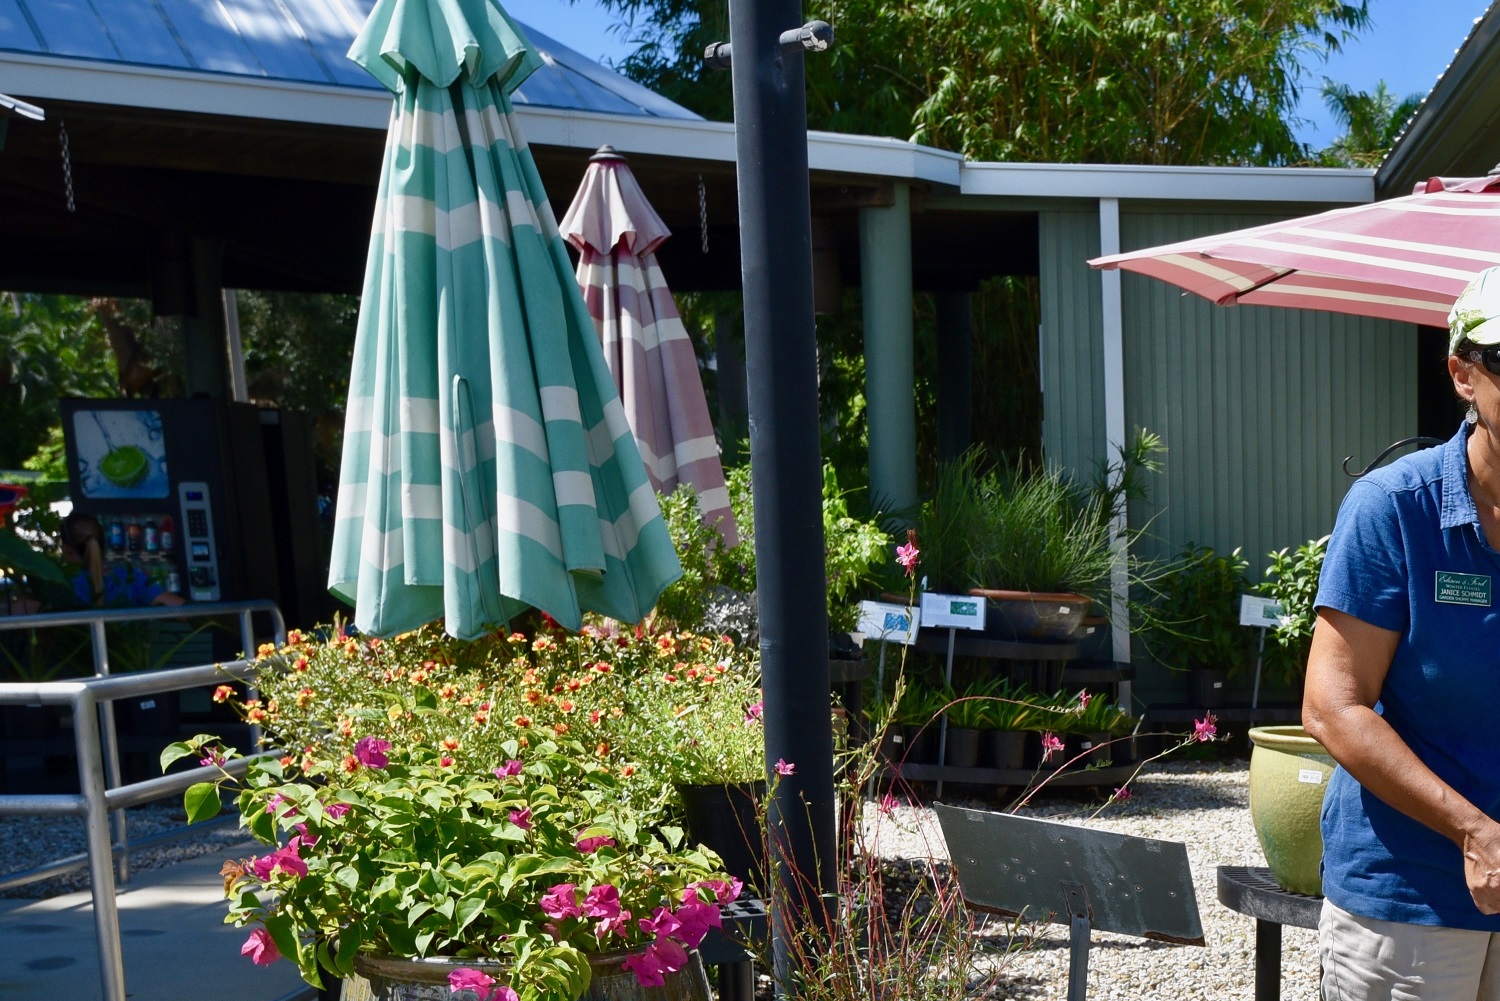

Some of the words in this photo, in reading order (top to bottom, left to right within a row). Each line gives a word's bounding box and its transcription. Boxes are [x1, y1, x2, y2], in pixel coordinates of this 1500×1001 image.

[1470, 576, 1488, 587] Ford
[1440, 588, 1460, 597] JANICE
[1461, 590, 1487, 599] SCHMIDT
